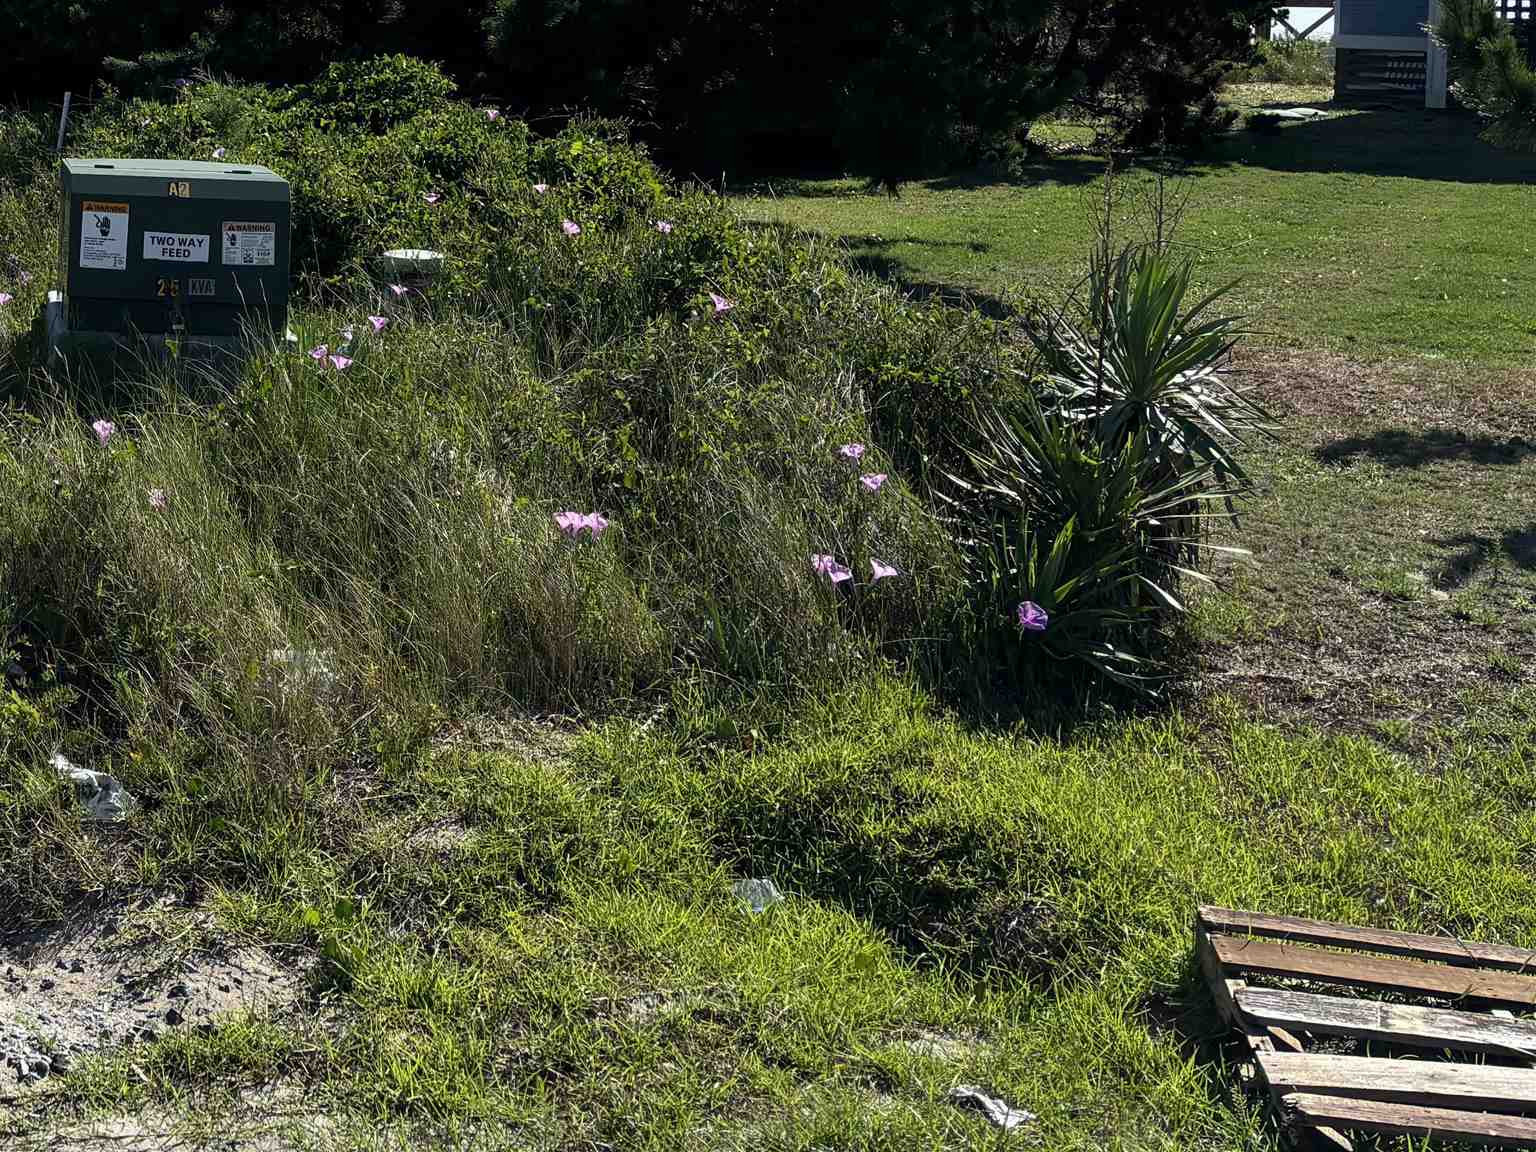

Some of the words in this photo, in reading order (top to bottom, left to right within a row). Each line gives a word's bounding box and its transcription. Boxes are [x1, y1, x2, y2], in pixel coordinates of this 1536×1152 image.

[236, 224, 271, 232] WARNING
[150, 236, 175, 247] TWO
[178, 237, 205, 248] WAY
[161, 248, 191, 259] FEED
